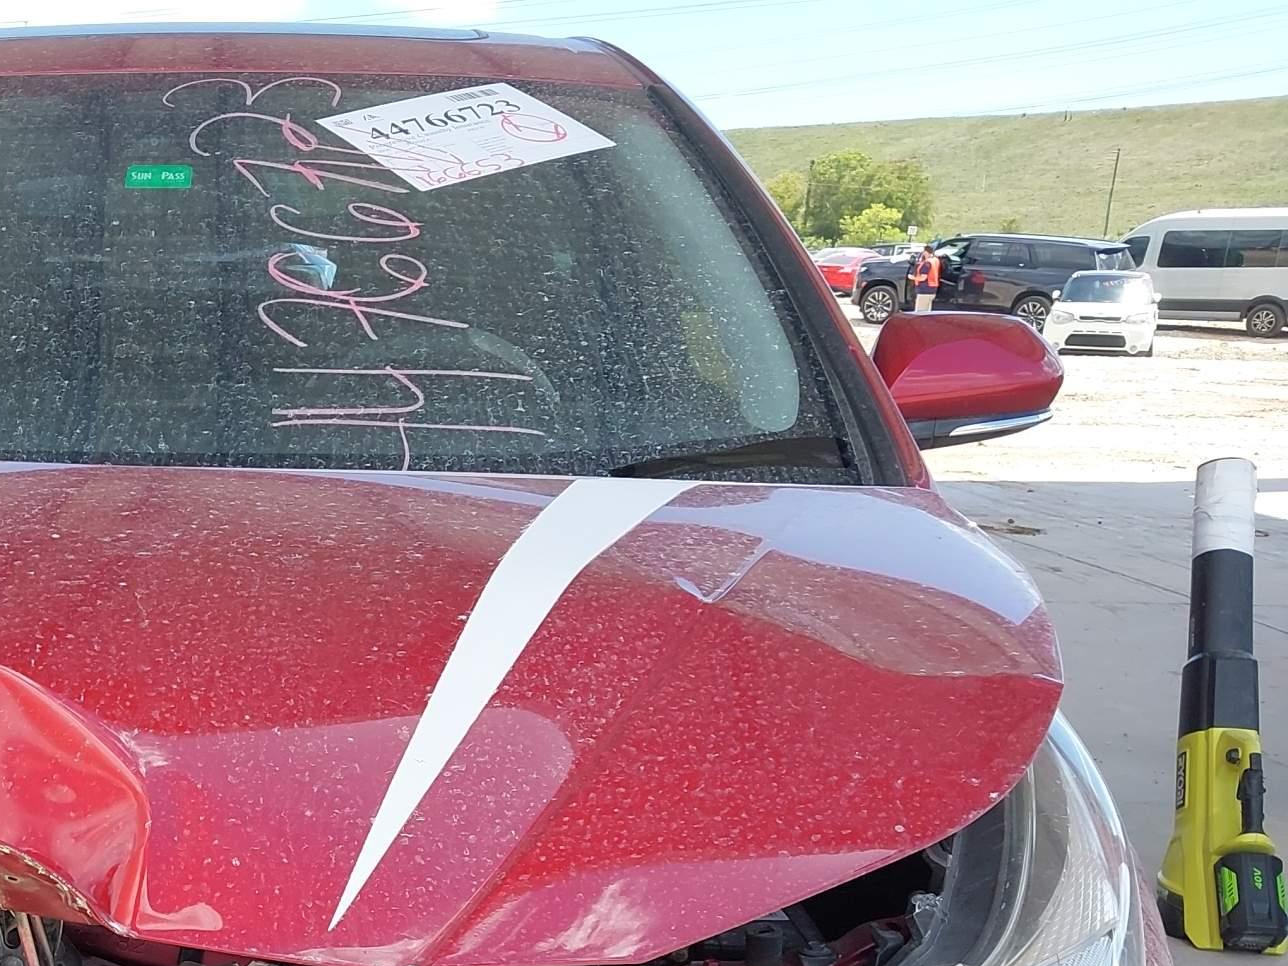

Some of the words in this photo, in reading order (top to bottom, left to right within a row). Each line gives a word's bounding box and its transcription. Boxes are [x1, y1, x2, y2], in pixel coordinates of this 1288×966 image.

[370, 100, 521, 142] 44766723
[1177, 754, 1185, 806] RYOBI
[1253, 867, 1262, 889] 40V
